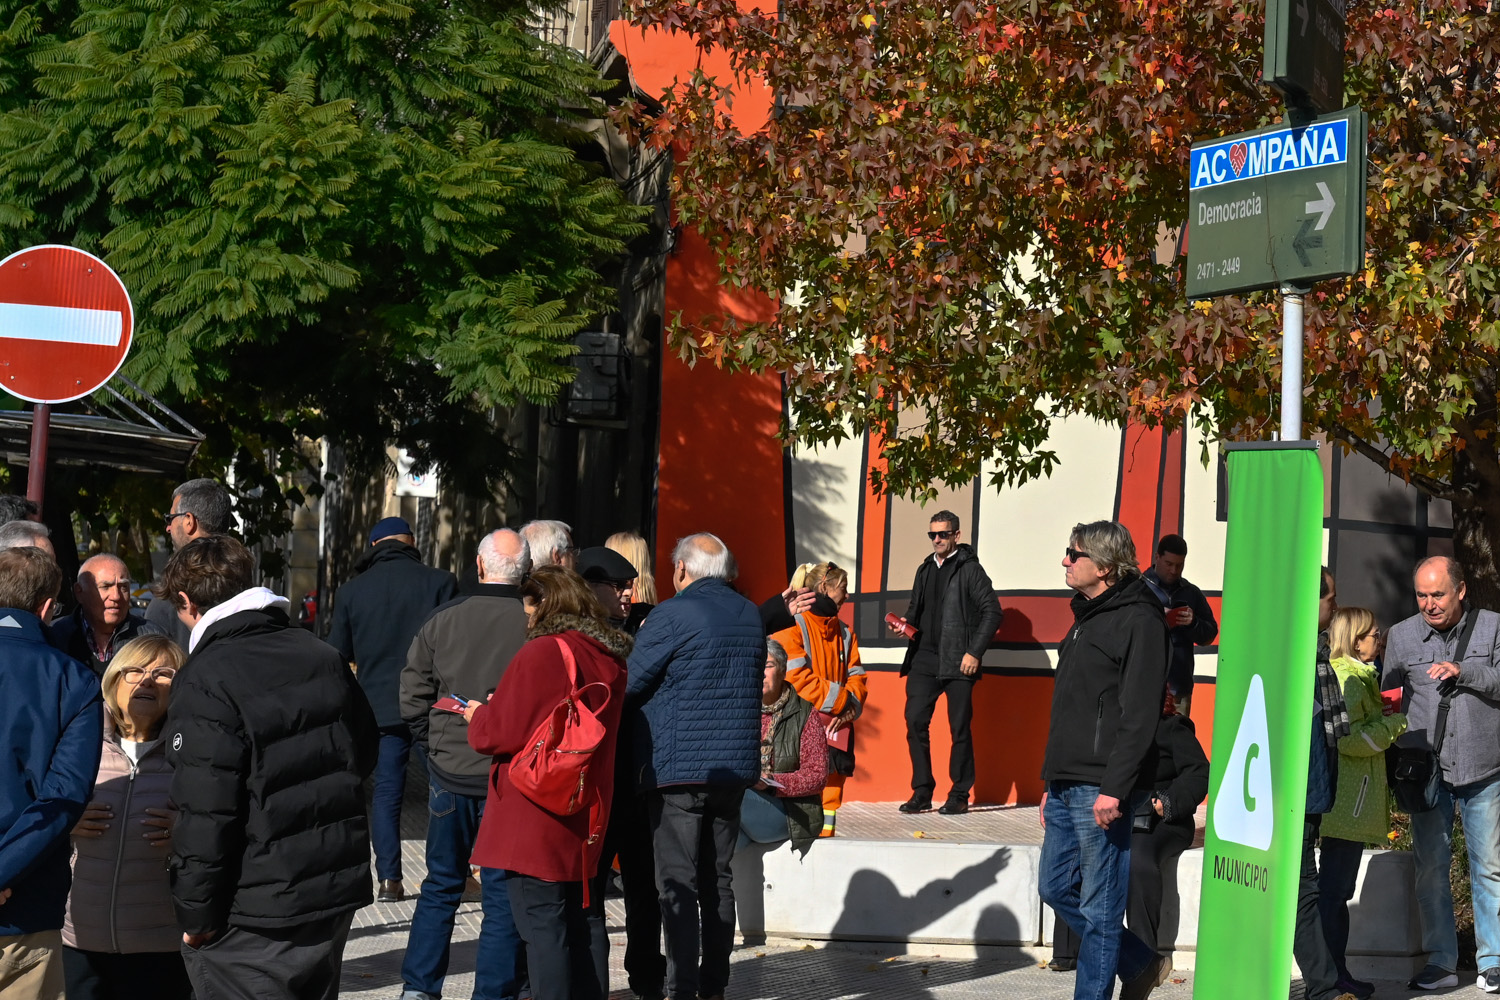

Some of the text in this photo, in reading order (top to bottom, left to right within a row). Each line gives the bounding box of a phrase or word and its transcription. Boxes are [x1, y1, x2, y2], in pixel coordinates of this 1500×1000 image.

[1198, 191, 1262, 226] Democracia
[1196, 262, 1215, 280] 2471
[1222, 257, 1241, 276] 2449
[1243, 742, 1260, 813] C
[1213, 855, 1269, 893] MUNICIPIO
